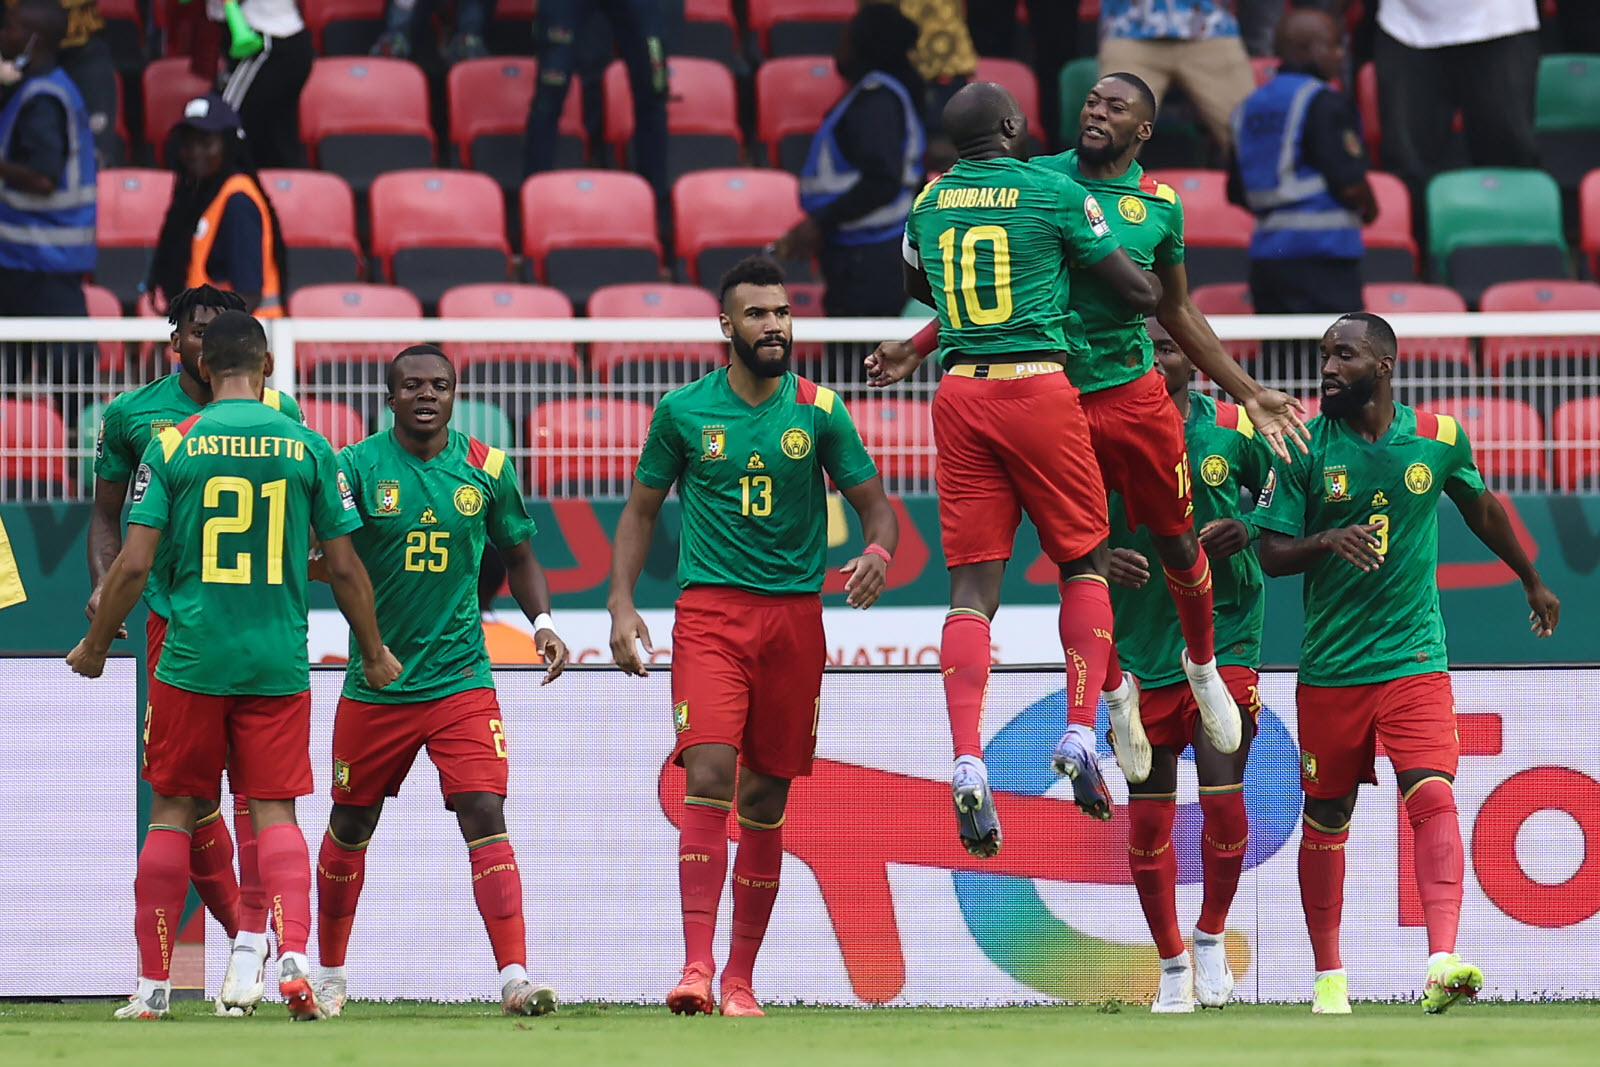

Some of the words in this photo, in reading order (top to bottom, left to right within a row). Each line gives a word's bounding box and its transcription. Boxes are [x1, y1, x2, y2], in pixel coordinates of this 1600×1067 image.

[936, 187, 1020, 210] ABOUBAKAR
[938, 225, 1013, 329] 10
[186, 435, 305, 461] CASTELLETTO
[739, 475, 773, 517] 13
[202, 476, 287, 585] 21
[405, 531, 450, 573] 25
[1367, 513, 1389, 556] 3
[1066, 647, 1088, 707] CAMEROUN
[154, 907, 169, 971] CAMEROUN
